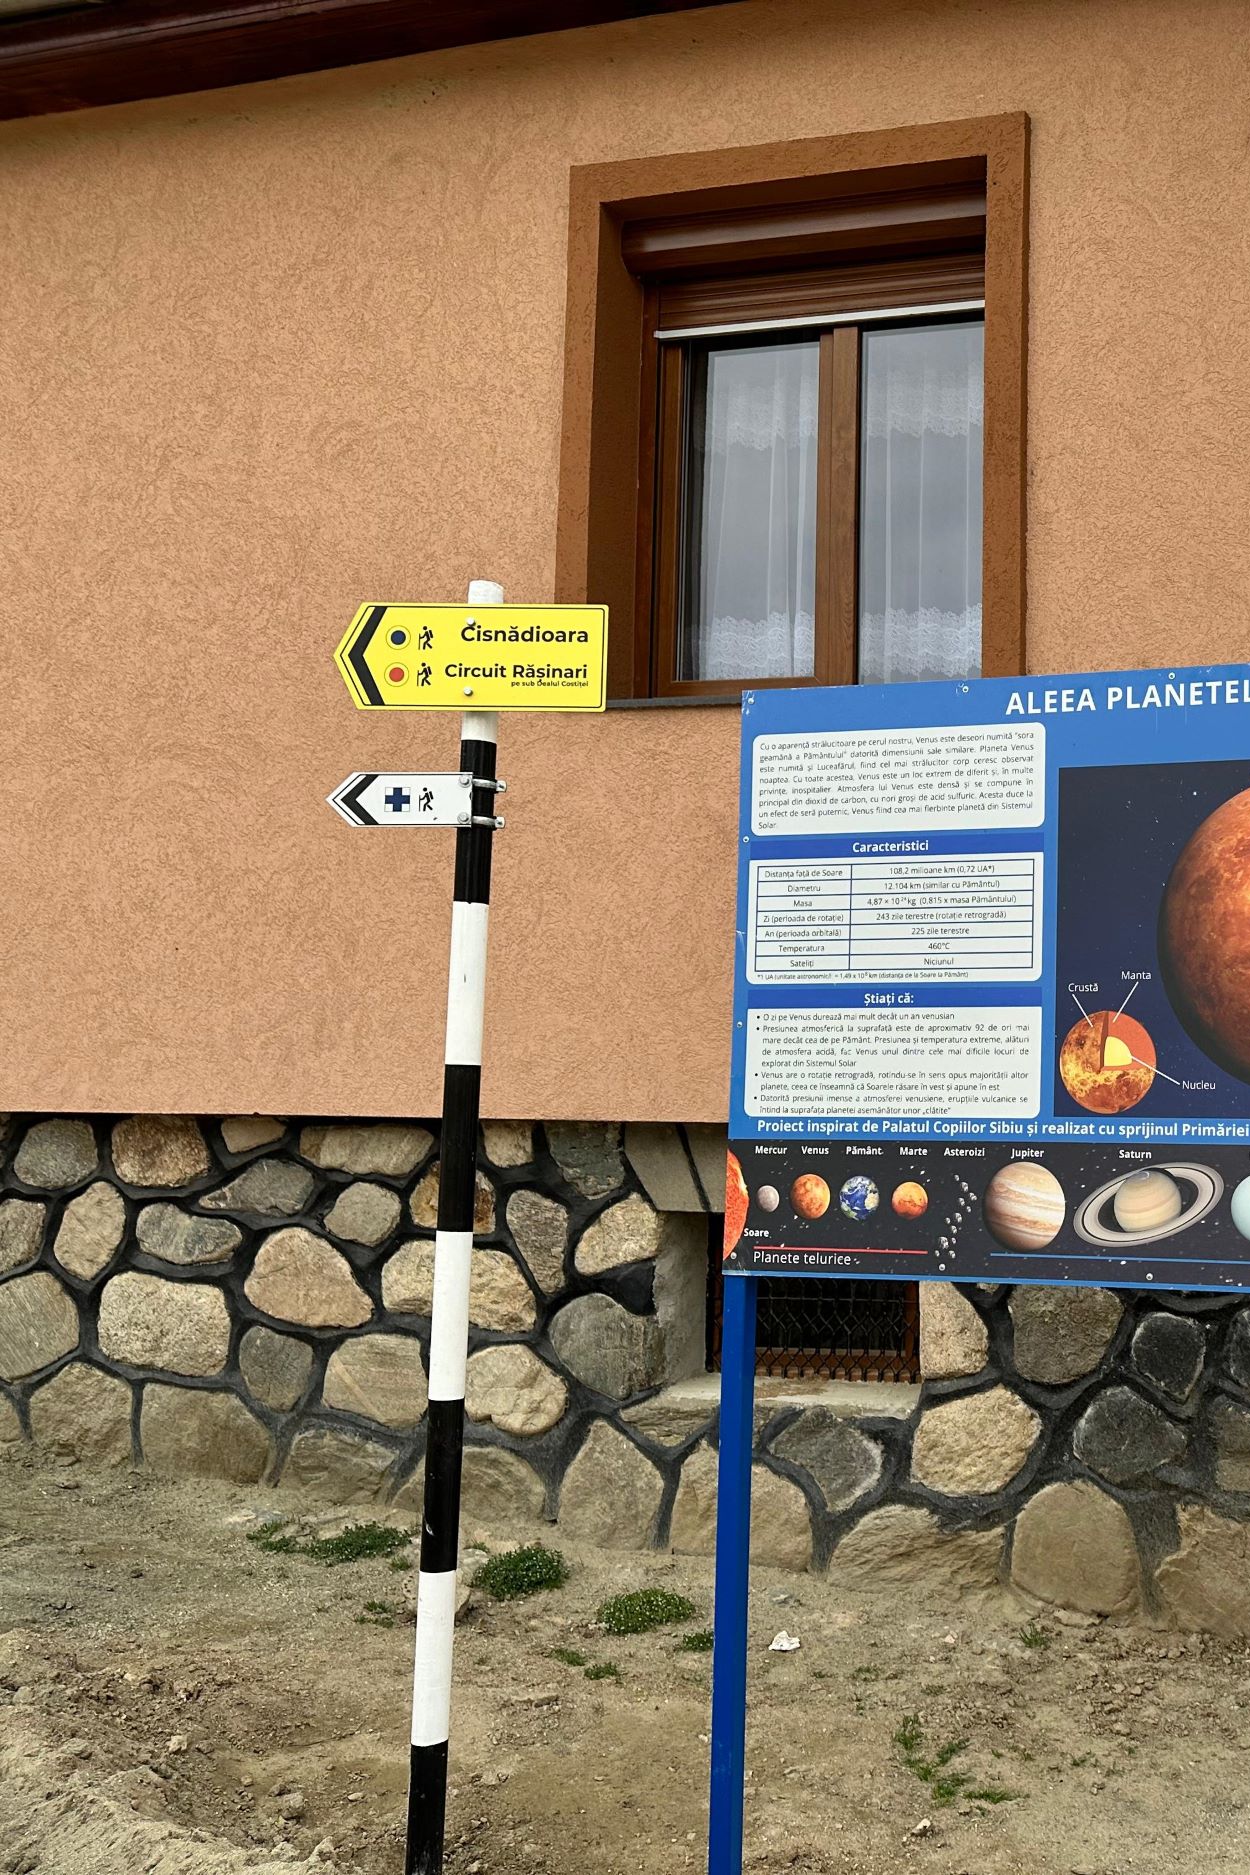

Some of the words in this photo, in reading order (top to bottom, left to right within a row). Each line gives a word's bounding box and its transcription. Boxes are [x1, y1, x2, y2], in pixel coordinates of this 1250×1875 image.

[460, 624, 588, 642] Cisnădioara
[444, 662, 506, 678] Circuit
[512, 663, 588, 683] Rășinari
[1005, 688, 1096, 715] ALEEA
[852, 839, 928, 852] Caracteristici
[787, 884, 822, 892] Diametru
[778, 943, 824, 954] Temperatura
[923, 957, 954, 965] Niciunul
[1121, 971, 1152, 980] Manta
[1068, 983, 1099, 992] Crustă
[863, 992, 894, 1006] Știați
[897, 992, 914, 1003] că:
[1182, 1081, 1216, 1090] Nucleu
[757, 1119, 804, 1131] Proiect
[807, 1119, 858, 1135] inspirat
[861, 1119, 878, 1132] de
[882, 1119, 929, 1132] Palatul
[933, 1120, 986, 1136] Copiilor
[989, 1120, 1023, 1133] Sibiu
[1026, 1121, 1037, 1137] și
[1042, 1121, 1095, 1134] realizat
[1098, 1125, 1114, 1134] cu
[1118, 1122, 1177, 1139] sprijinul
[1182, 1122, 1249, 1136] Primăriei
[755, 1146, 787, 1155] Mercur
[801, 1146, 829, 1155] Venus
[846, 1145, 883, 1156] Pământ
[900, 1147, 928, 1156] Marte
[944, 1147, 985, 1157] Asteroizi
[1011, 1148, 1044, 1159] Jupiter
[1119, 1150, 1152, 1159] Saturn
[744, 1228, 769, 1238] Soare
[753, 1252, 799, 1263] Planete
[804, 1252, 850, 1265] telurice
